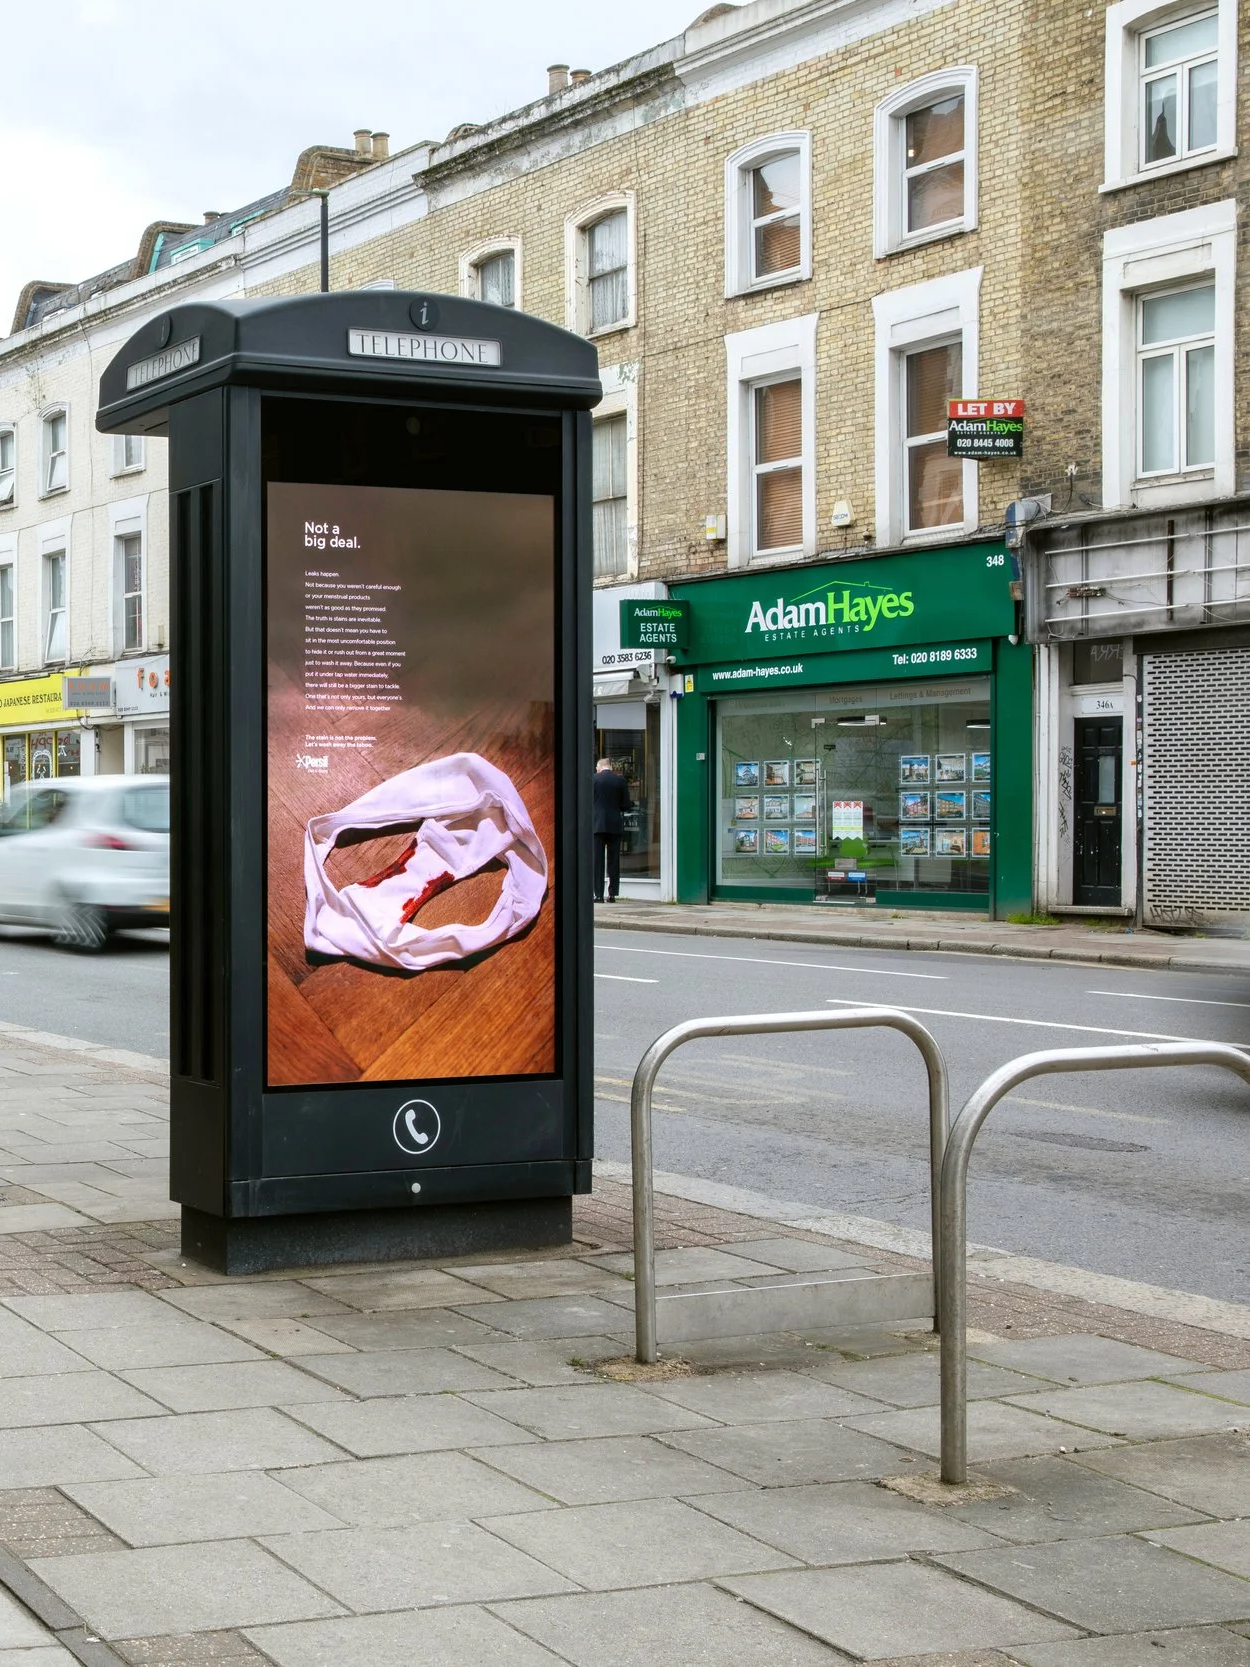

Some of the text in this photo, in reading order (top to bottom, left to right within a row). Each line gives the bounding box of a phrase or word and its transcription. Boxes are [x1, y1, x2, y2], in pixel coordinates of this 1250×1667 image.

[356, 333, 488, 363] TELEPHONE
[134, 341, 198, 386] TELEPHONE
[957, 402, 1017, 415] LET BY
[949, 420, 1023, 434] AdamHayes
[957, 439, 971, 448] 020
[973, 438, 993, 448] 8445
[305, 521, 340, 535] Not a
[305, 534, 361, 550] big deal.
[986, 554, 1004, 567] 348
[634, 607, 682, 619] AdamHayes
[745, 590, 915, 633] AdamHayes
[640, 623, 675, 632] ESTATE
[764, 624, 860, 642] ESTATE AGENTS
[639, 633, 677, 643] AGENTS
[602, 651, 652, 665] 020 3583 6236
[892, 648, 978, 665] Tel: 020 8189 6333
[712, 663, 803, 681] www.adam-hayes.co.uk
[3, 695, 31, 708] JAPANESE
[32, 692, 62, 704] RESTAURA
[830, 694, 863, 705] Mortgages
[890, 688, 971, 701] Lettings & Management
[305, 755, 329, 769] Persil
